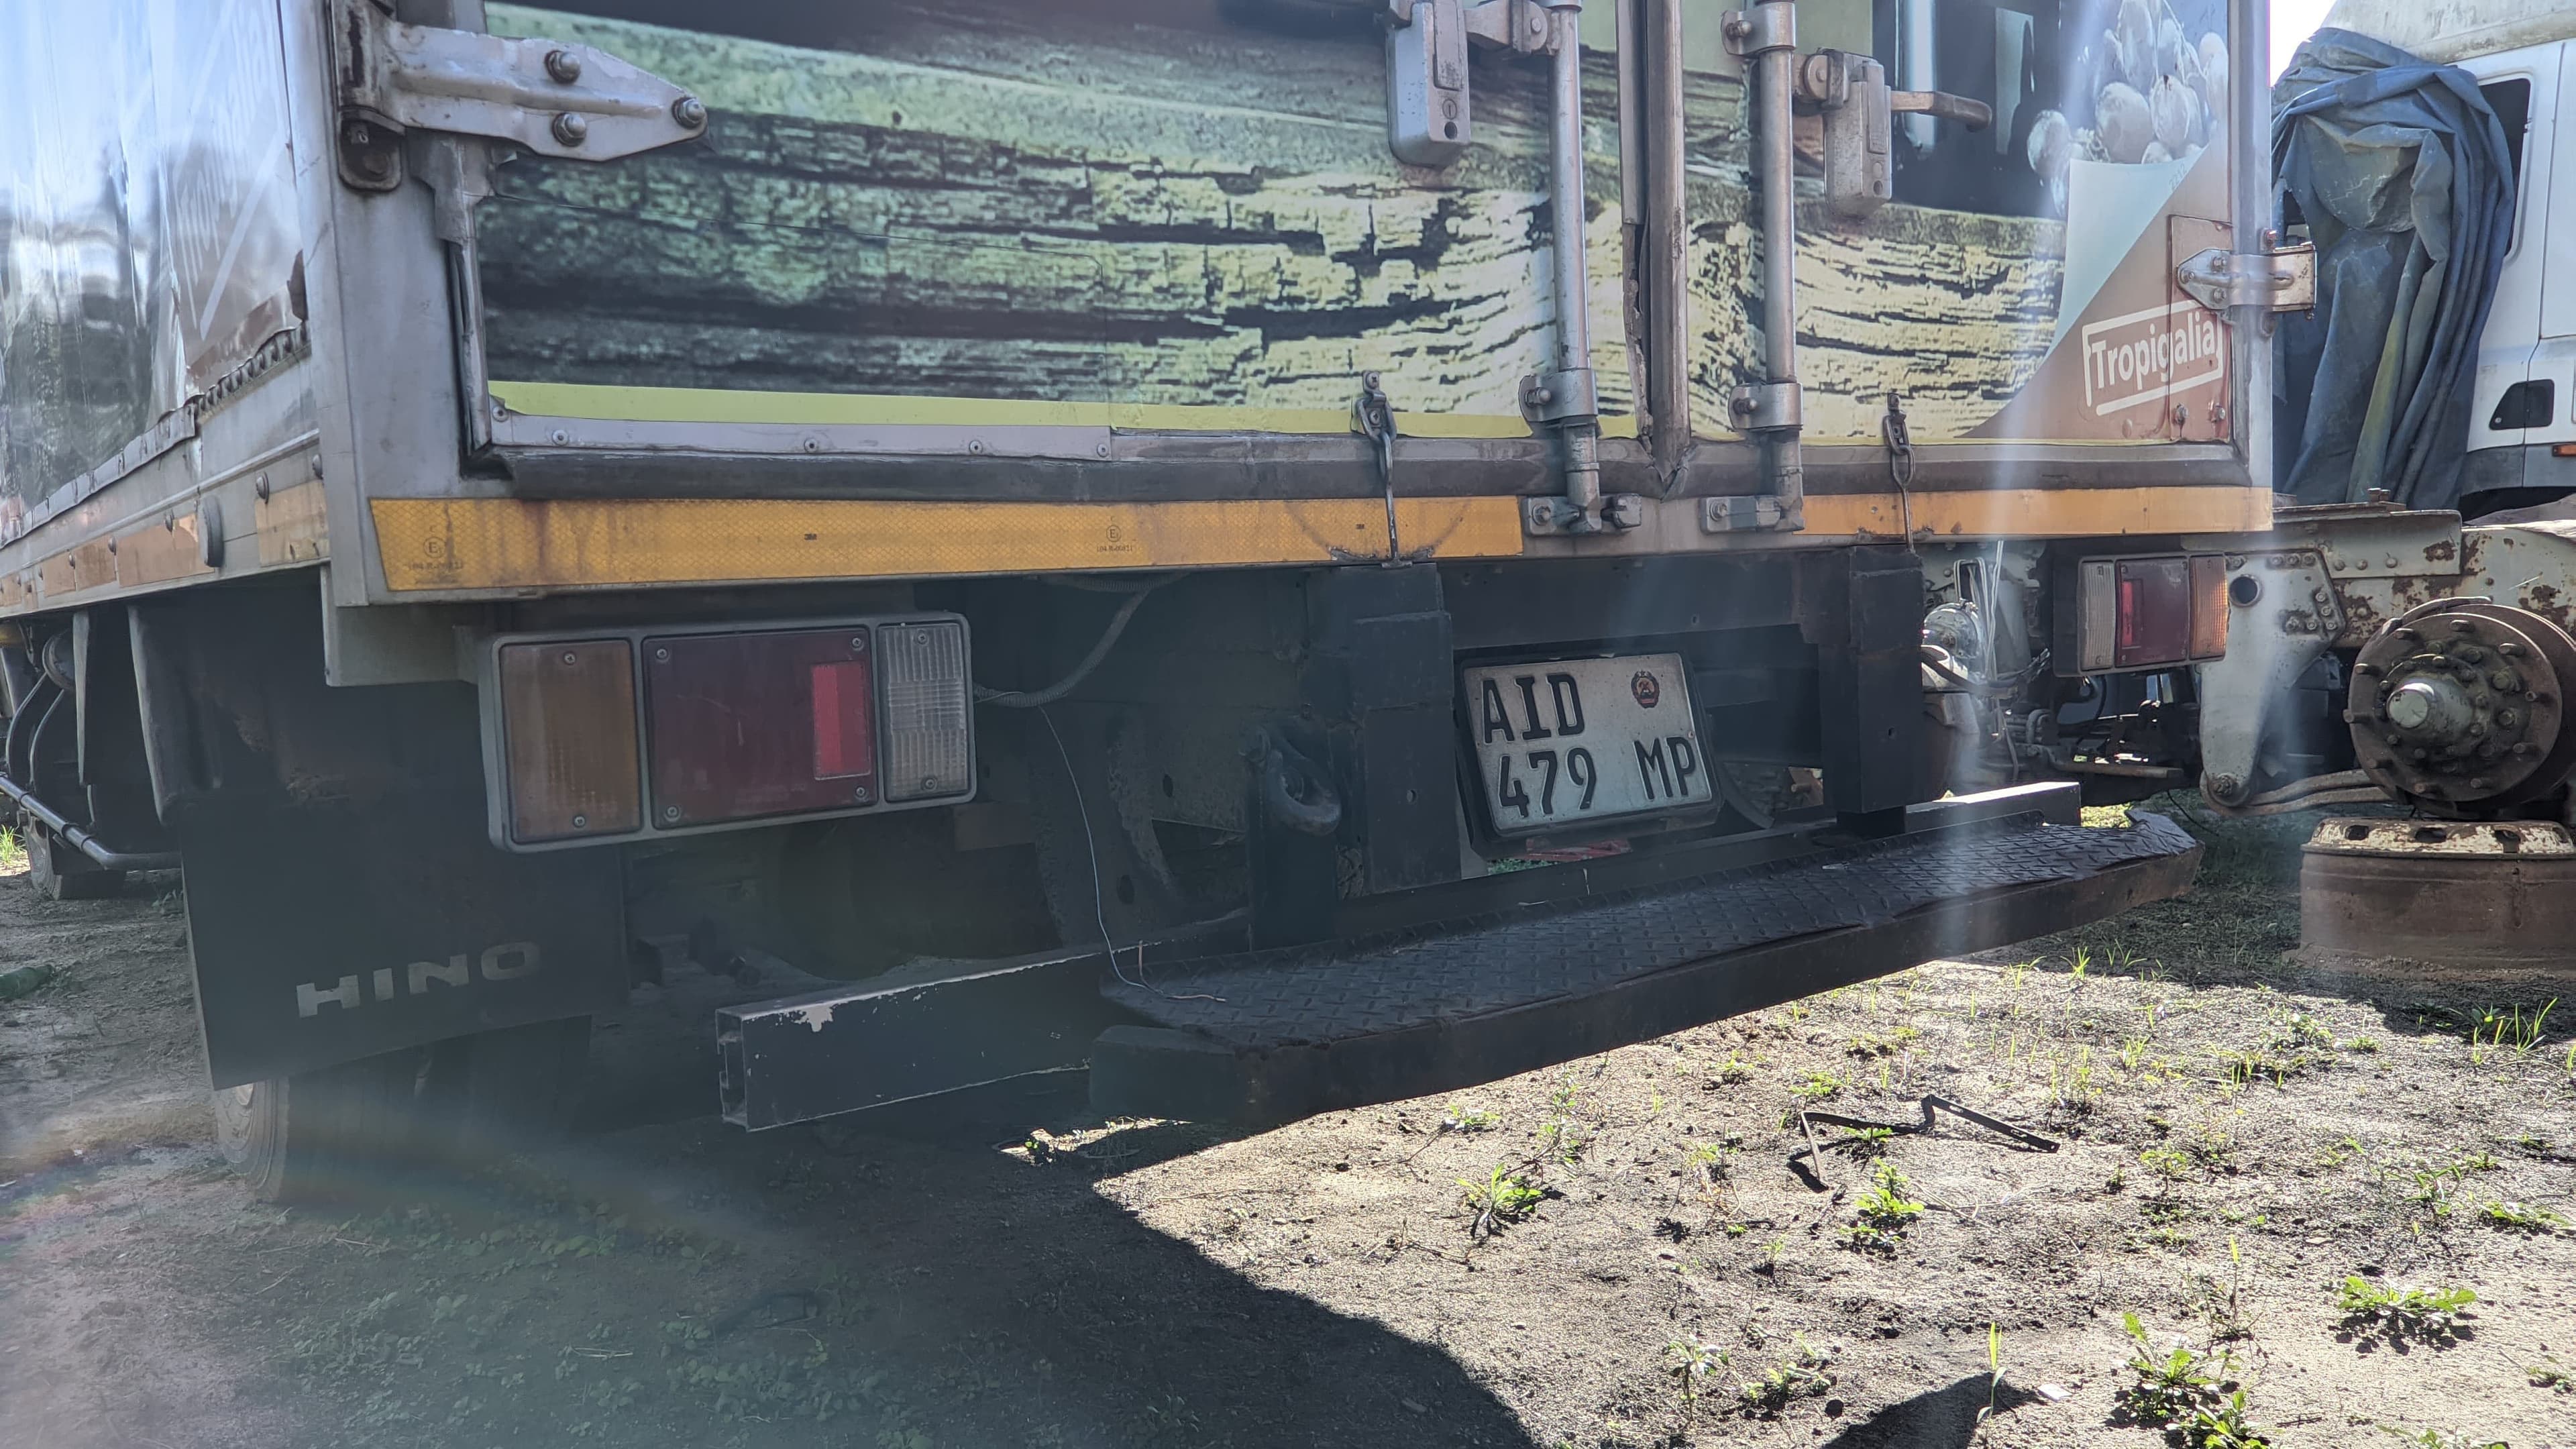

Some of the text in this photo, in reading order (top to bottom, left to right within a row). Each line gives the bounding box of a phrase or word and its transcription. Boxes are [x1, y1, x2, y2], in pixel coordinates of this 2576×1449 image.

[2091, 311, 2215, 390] Tropigalia
[1481, 673, 1585, 743] AID
[1499, 737, 1697, 818] 479 MP
[296, 941, 541, 1018] HINO
